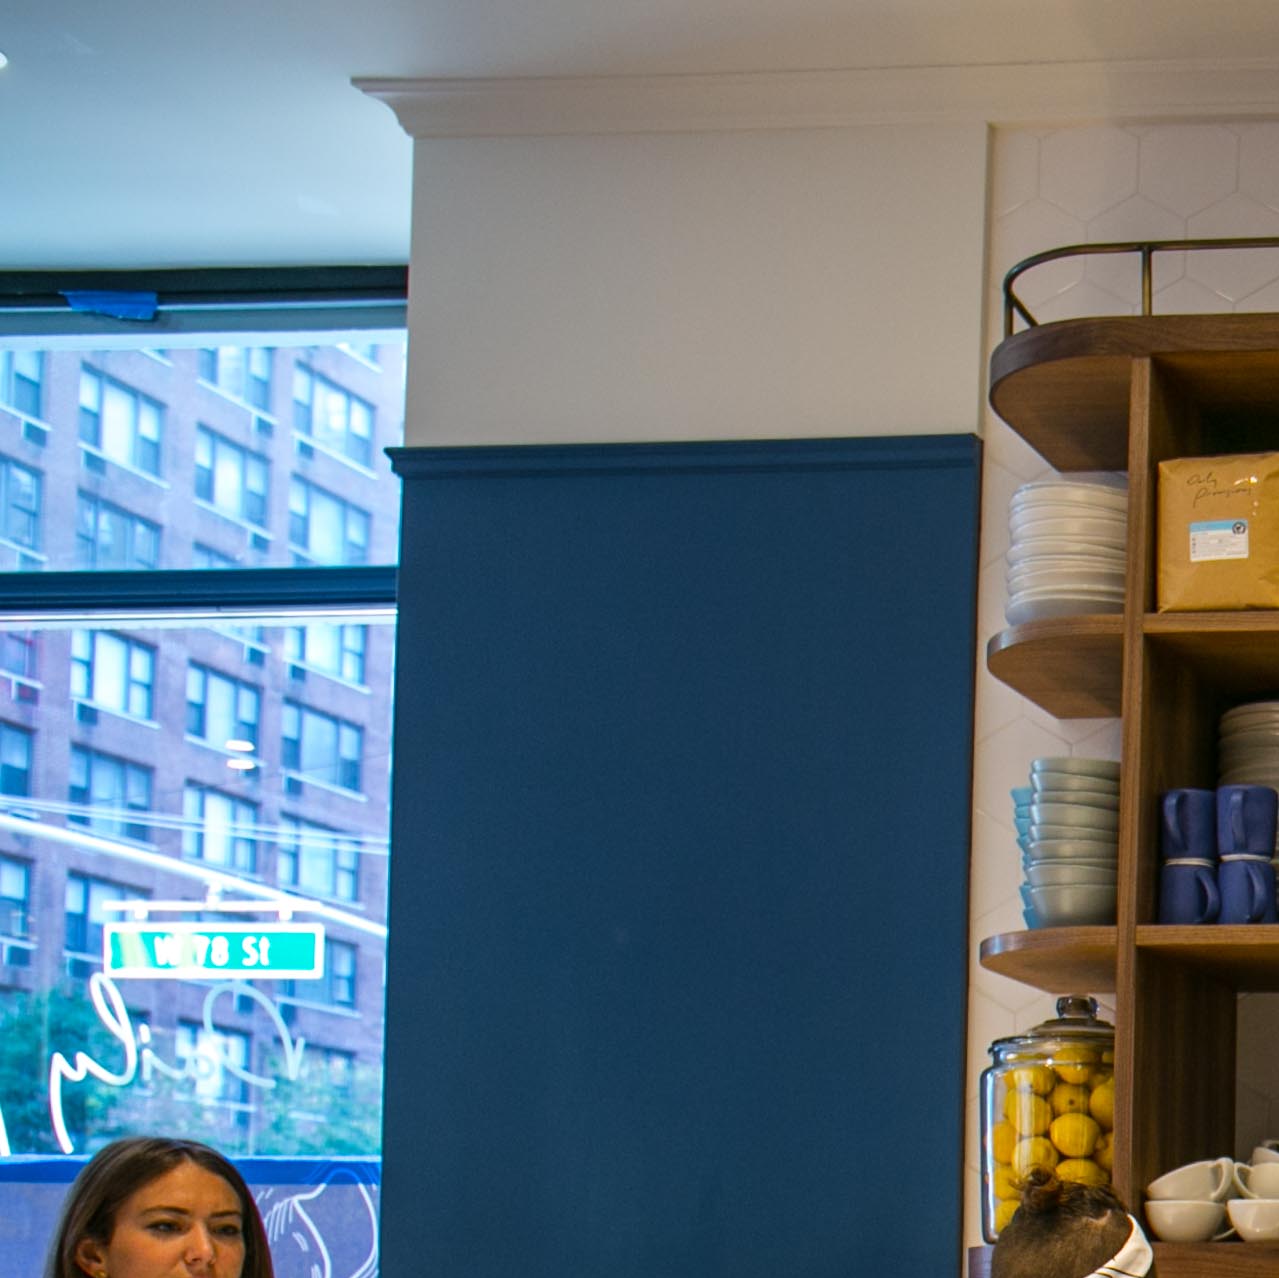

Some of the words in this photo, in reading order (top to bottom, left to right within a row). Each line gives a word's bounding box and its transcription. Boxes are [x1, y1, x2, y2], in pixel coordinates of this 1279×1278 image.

[154, 935, 181, 966] W
[192, 935, 230, 966] 78
[242, 935, 271, 966] St
